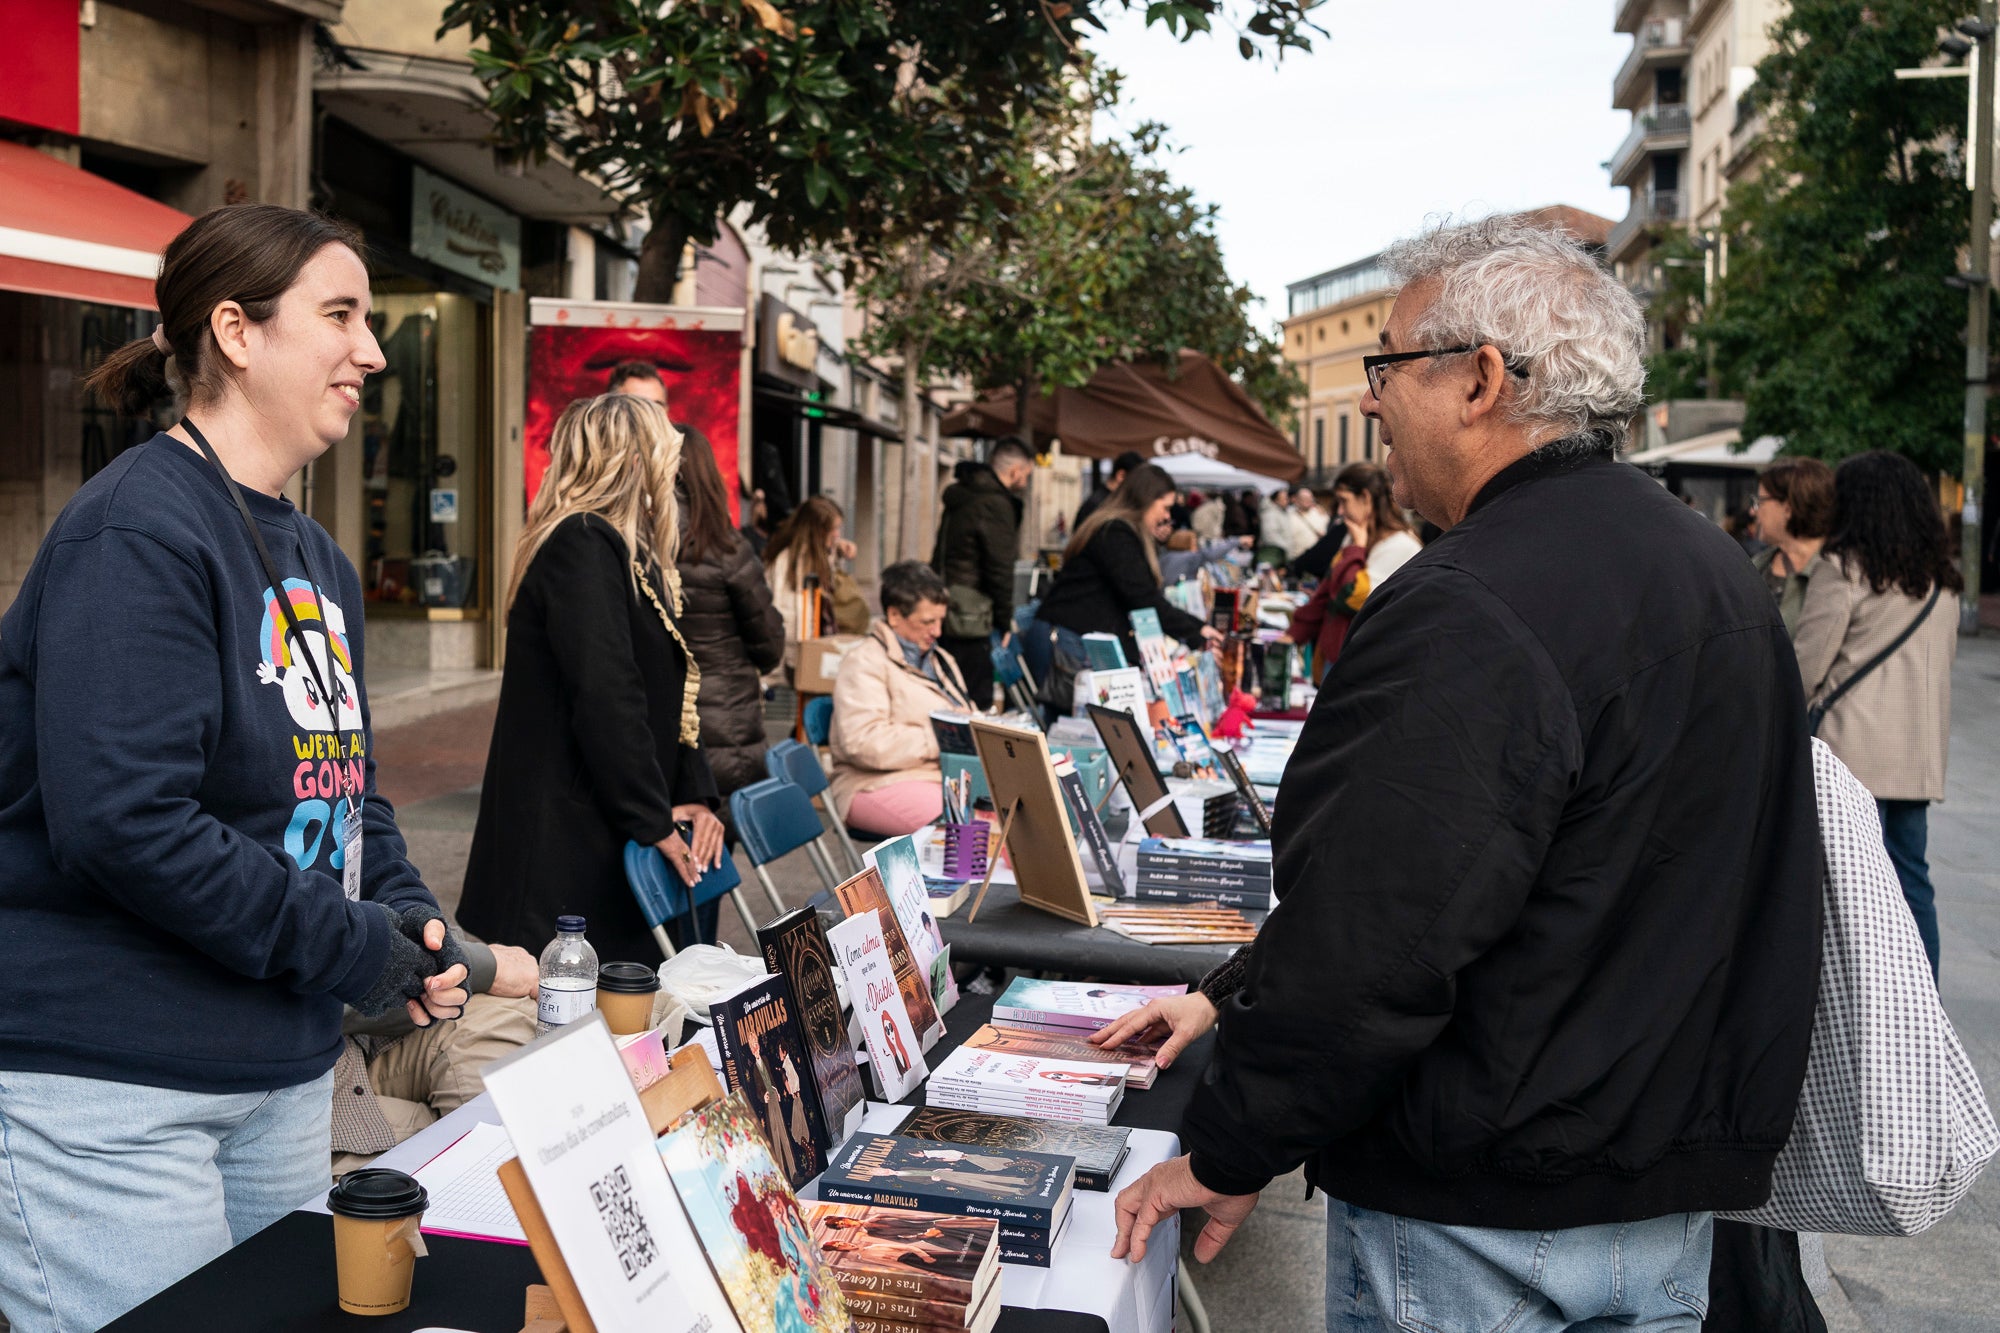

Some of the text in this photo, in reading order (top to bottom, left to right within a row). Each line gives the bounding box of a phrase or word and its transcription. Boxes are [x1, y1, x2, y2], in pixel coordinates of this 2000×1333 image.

[861, 933, 881, 957] alma
[867, 977, 895, 1012] Diablo
[737, 997, 787, 1046] MARAVILLAS
[828, 1188, 919, 1208] Un universo de MARAVILLAS
[834, 1270, 923, 1294] Tras el lienzo
[876, 1301, 886, 1314] el
[890, 1304, 917, 1318] Tras
